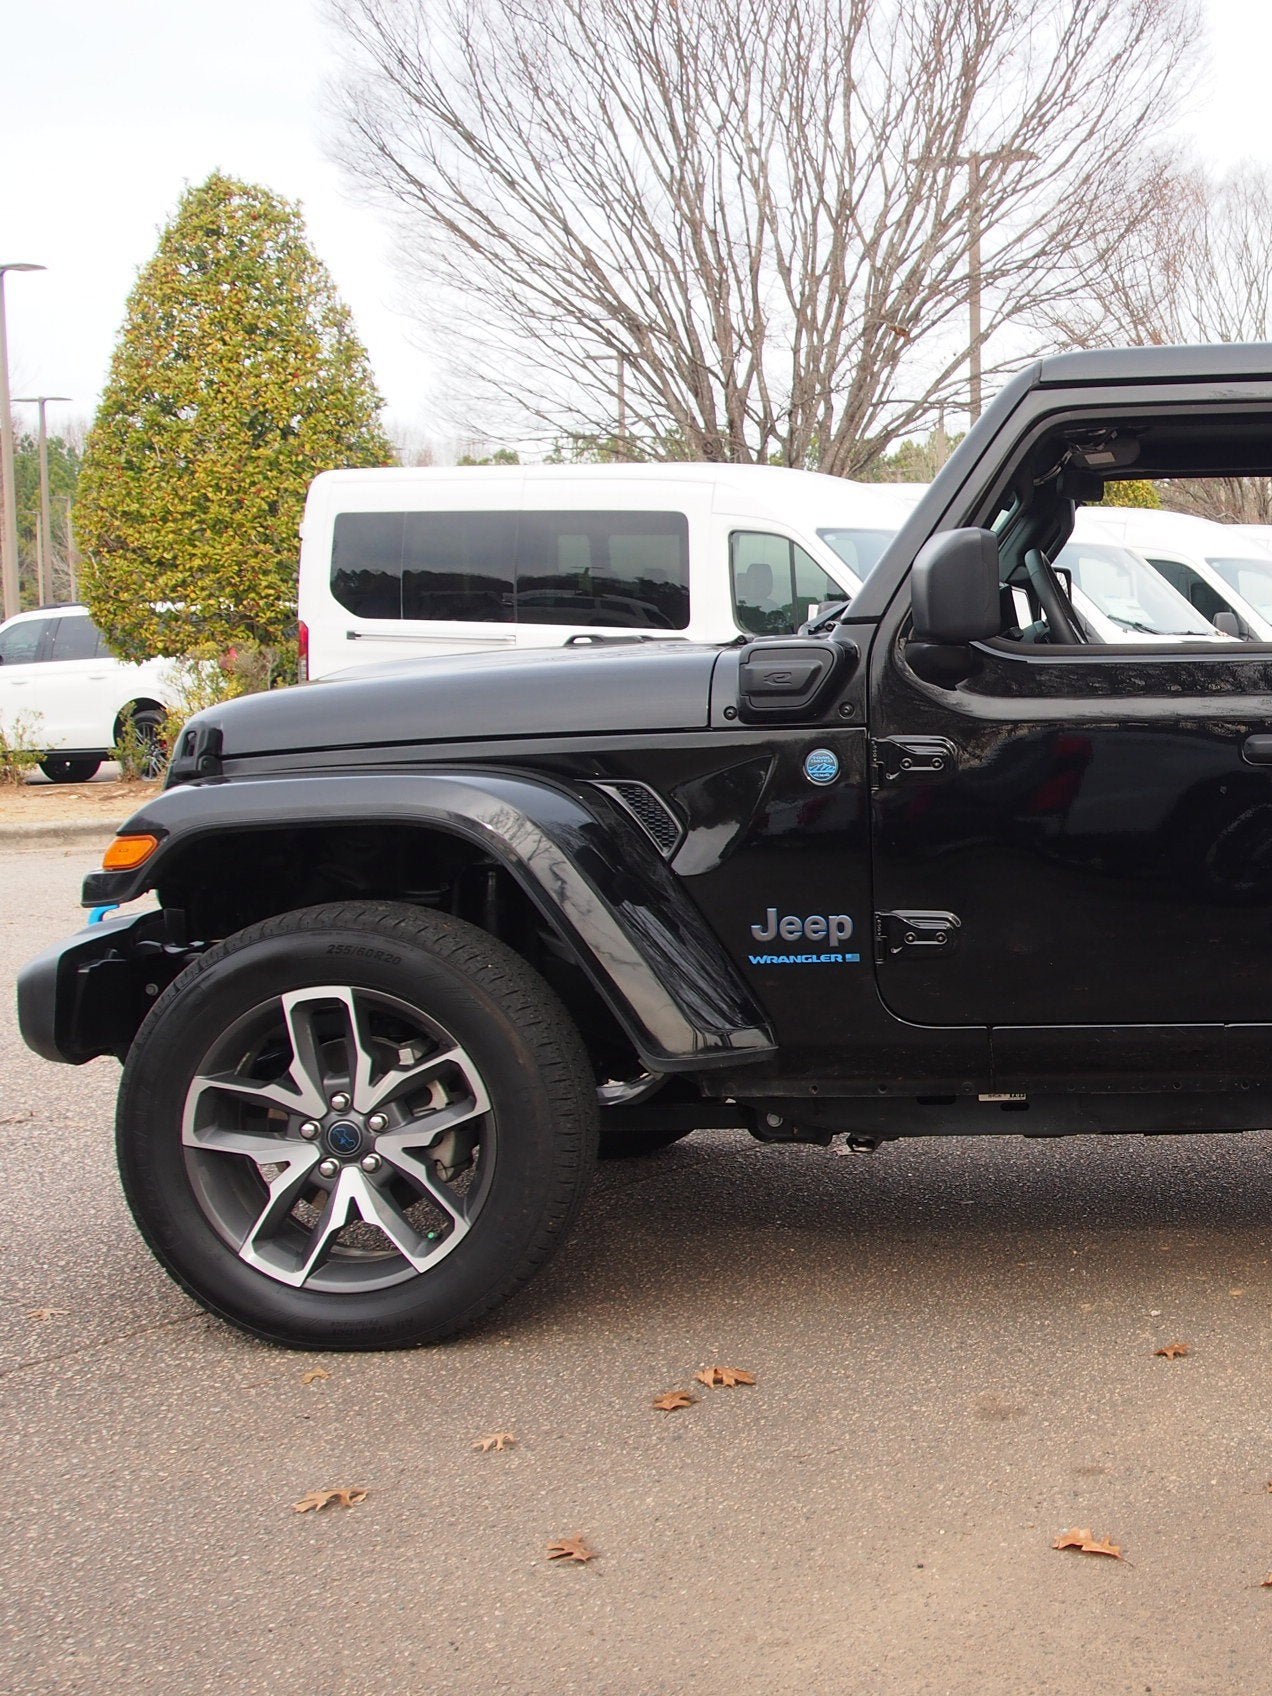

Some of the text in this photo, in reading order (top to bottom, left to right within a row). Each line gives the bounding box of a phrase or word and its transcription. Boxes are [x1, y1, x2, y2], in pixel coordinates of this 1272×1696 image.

[751, 908, 853, 947] Jeep
[326, 944, 402, 966] 255/60R20
[748, 953, 843, 965] WRANGLER
